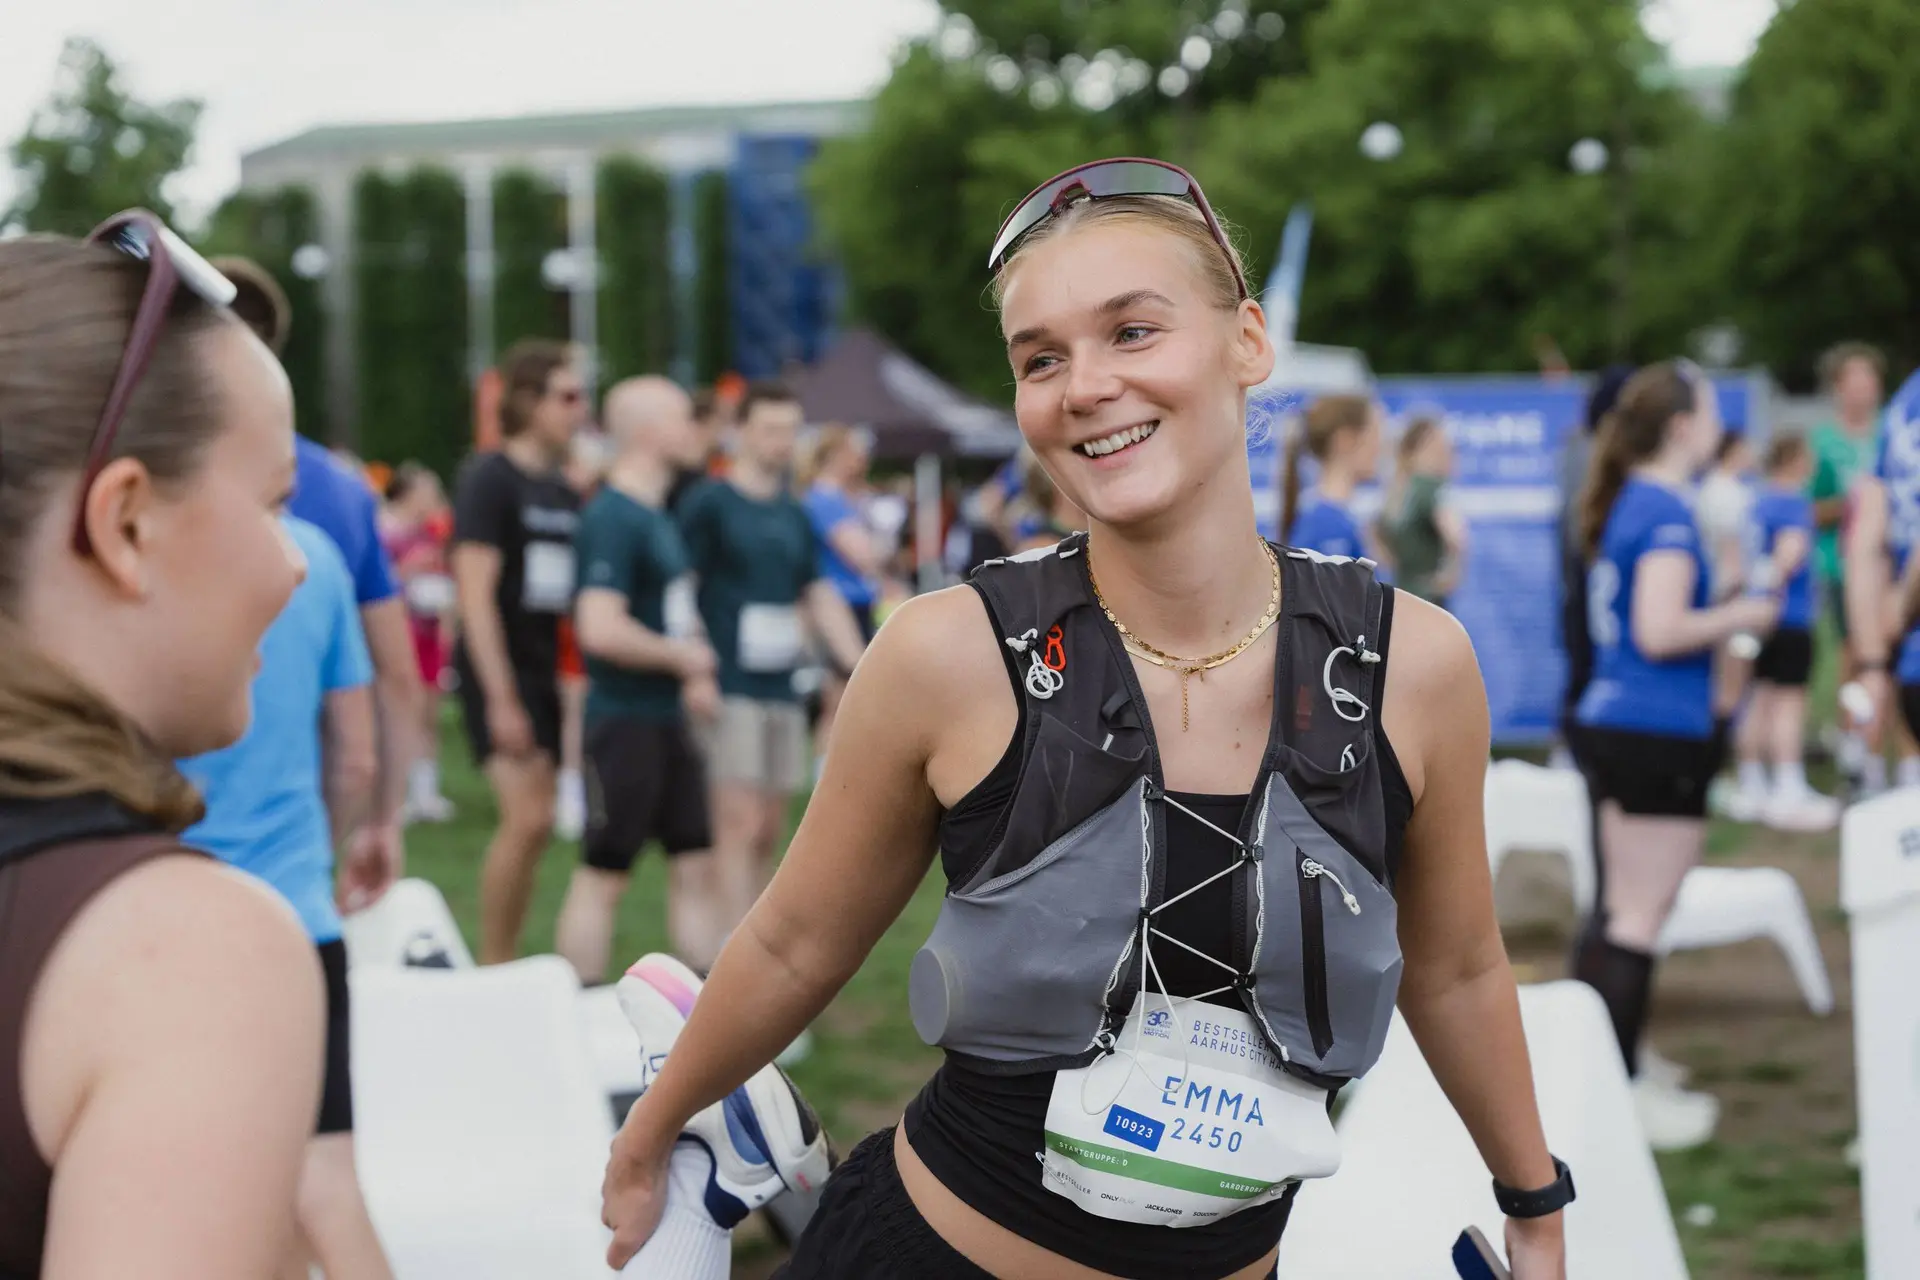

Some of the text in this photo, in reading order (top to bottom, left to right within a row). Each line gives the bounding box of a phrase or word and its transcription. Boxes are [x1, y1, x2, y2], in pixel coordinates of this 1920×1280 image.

[1143, 1031, 1169, 1039] MOTION
[1190, 1034, 1246, 1057] AARHUS
[1249, 1049, 1268, 1068] CITY
[1162, 1076, 1264, 1126] EMMA
[1115, 1115, 1153, 1139] 10923
[1170, 1118, 1242, 1153] 2450
[1059, 1141, 1119, 1165] STARTGRUPPE:
[1057, 1171, 1091, 1195] BESTSELLER
[1145, 1203, 1183, 1216] JACK&JONES
